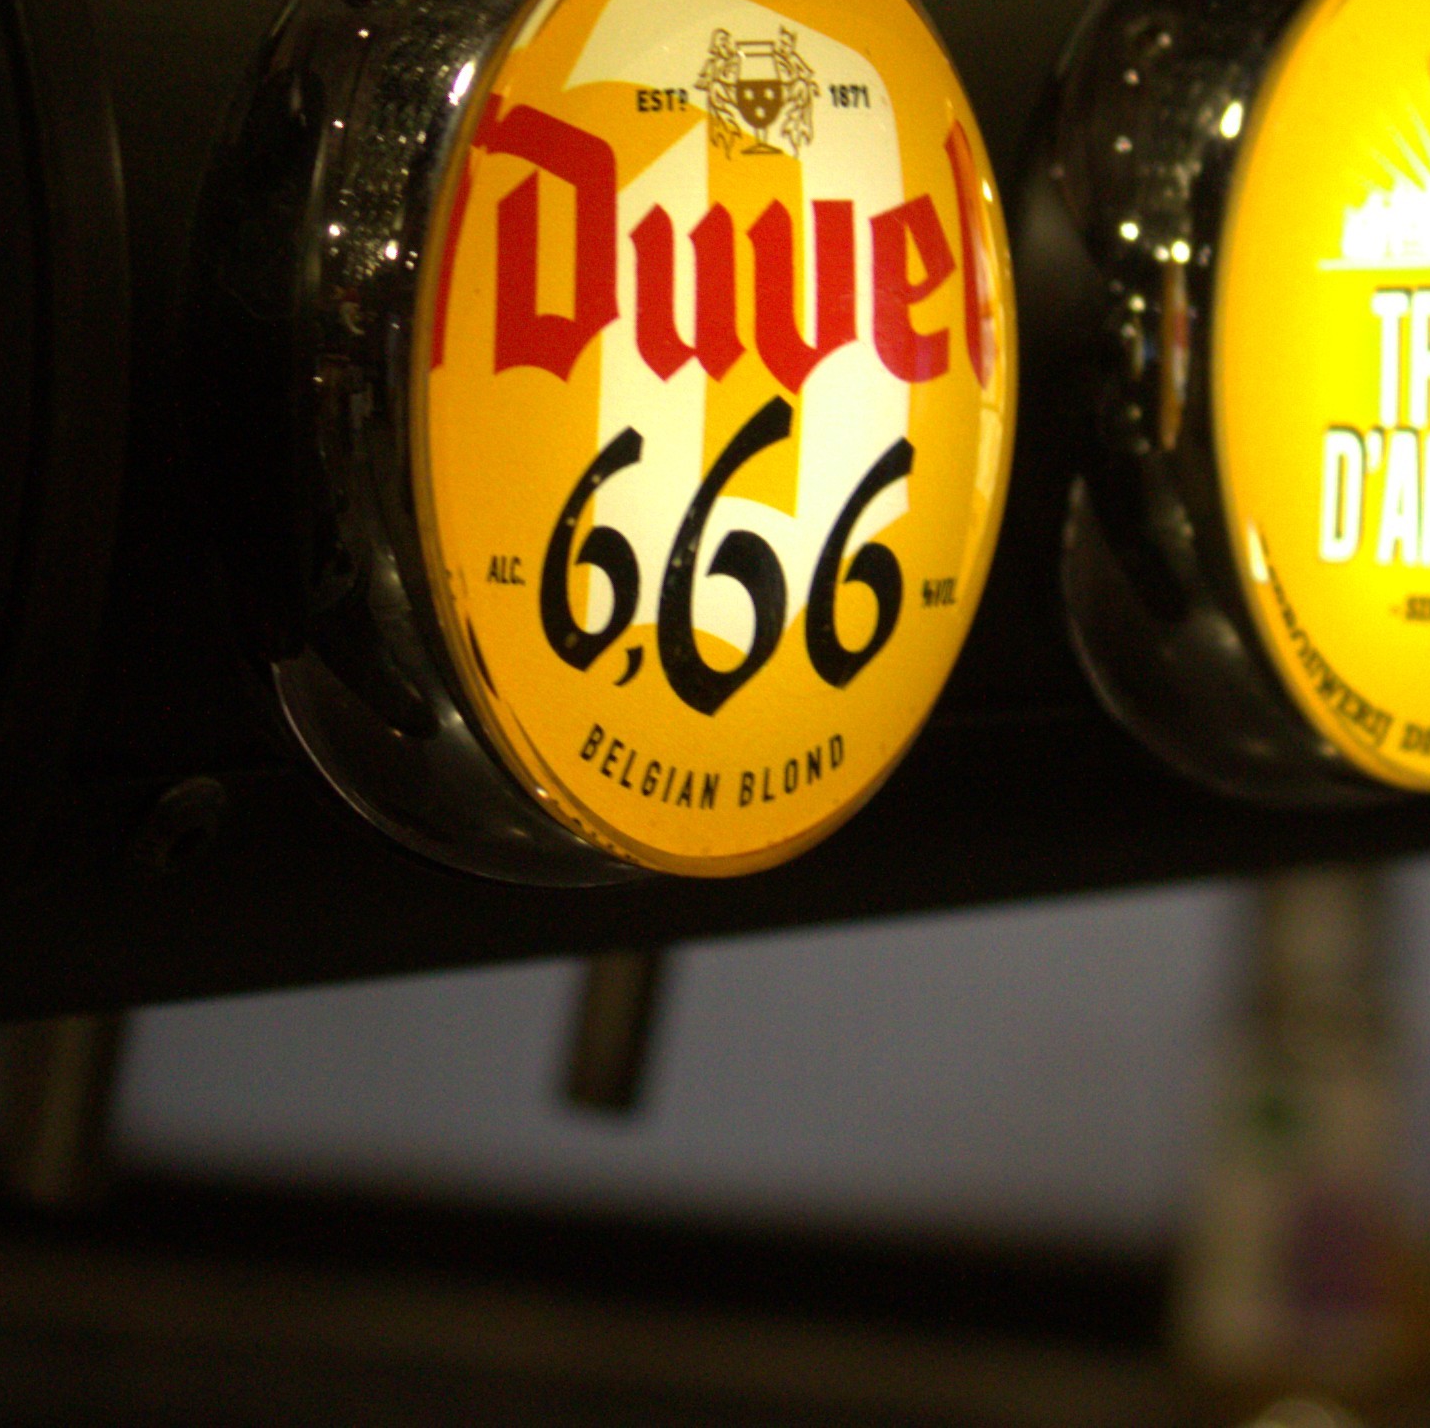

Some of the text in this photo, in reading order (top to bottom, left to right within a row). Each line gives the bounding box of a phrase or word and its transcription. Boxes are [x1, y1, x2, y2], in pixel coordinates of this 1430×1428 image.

[829, 85, 870, 108] 1871
[432, 92, 995, 395] Duvel
[486, 555, 526, 586] ALC.
[539, 397, 916, 716] 6,66
[579, 723, 845, 809] BELGIAN BLOND
